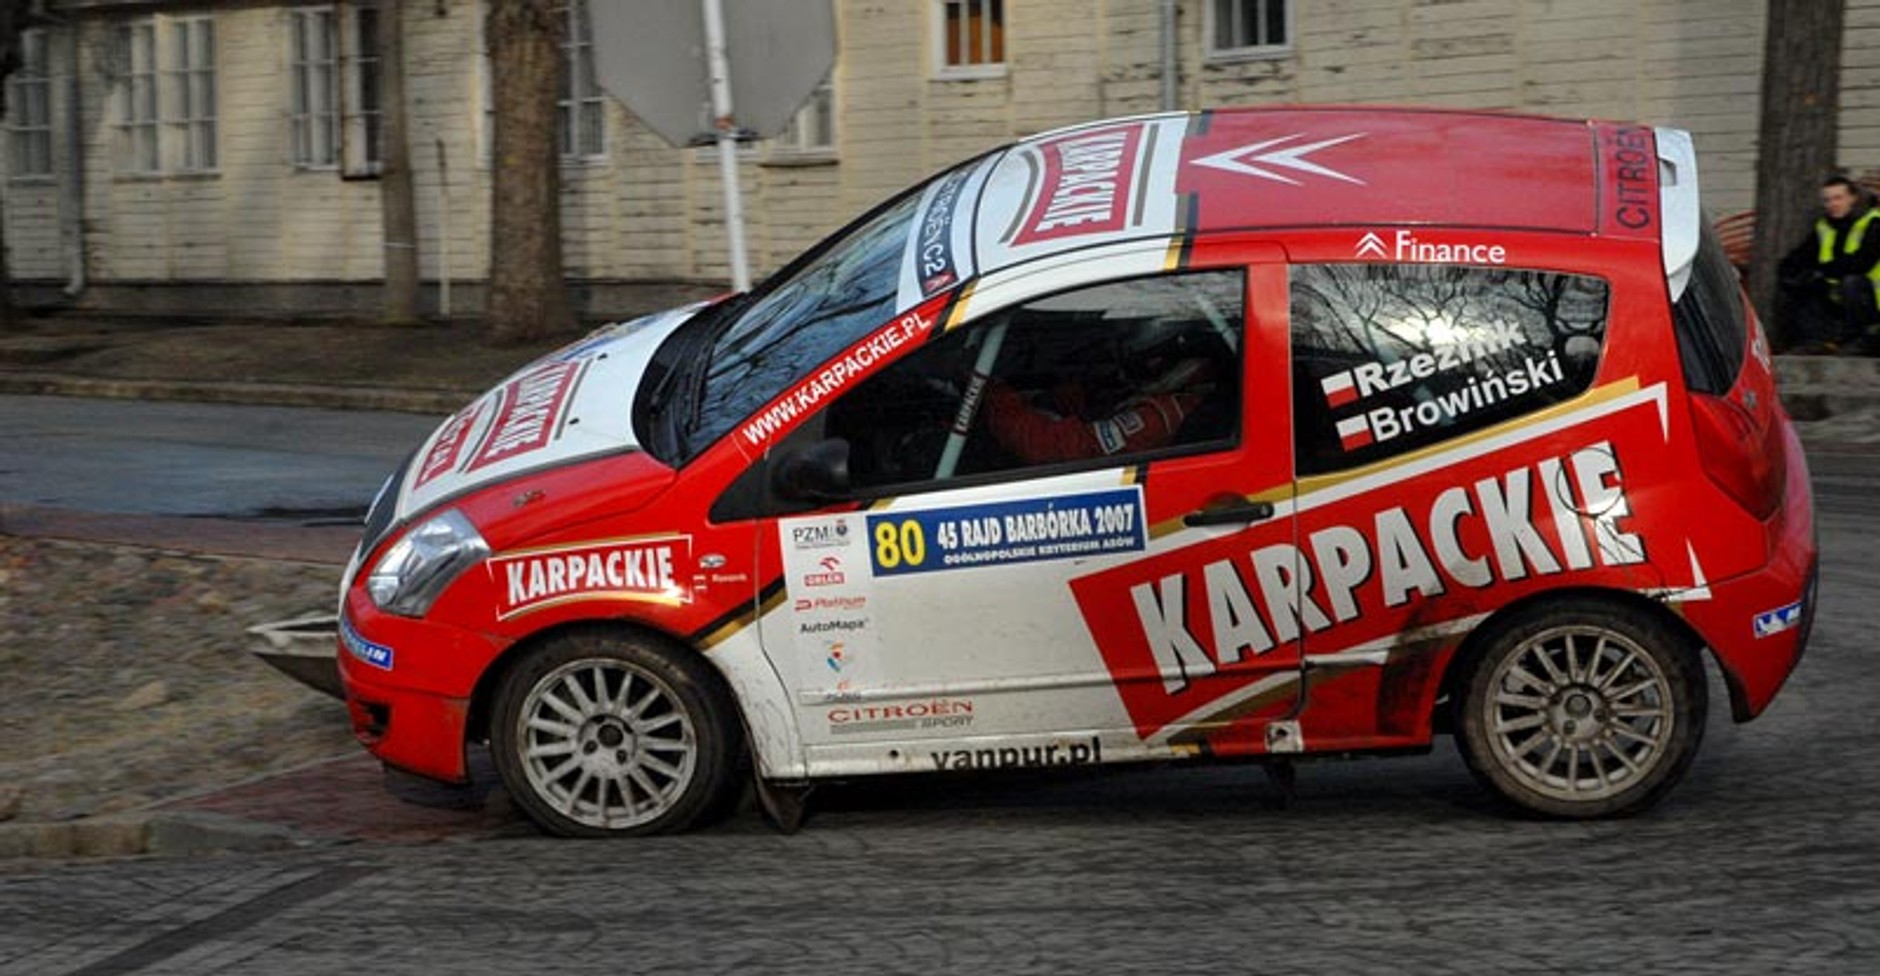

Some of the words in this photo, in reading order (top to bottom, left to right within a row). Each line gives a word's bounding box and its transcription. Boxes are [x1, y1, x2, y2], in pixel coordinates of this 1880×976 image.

[1034, 131, 1129, 232] KARPACKIE
[924, 241, 947, 278] C2
[1395, 230, 1506, 264] Finance
[742, 312, 932, 446] WWW.KARPACKIE.PL
[1368, 351, 1565, 443] Browiński
[793, 526, 828, 542] PZM
[874, 519, 925, 569] 80
[937, 520, 957, 549] 45
[963, 513, 1002, 547] RAJD
[1004, 502, 1092, 543] BARBÓRKA
[1094, 503, 1135, 533] 2007
[506, 546, 676, 606] KARPACKIE
[1130, 438, 1648, 697] KARPACKIE
[800, 620, 866, 634] AutoMapa
[827, 698, 974, 723] CITROËN
